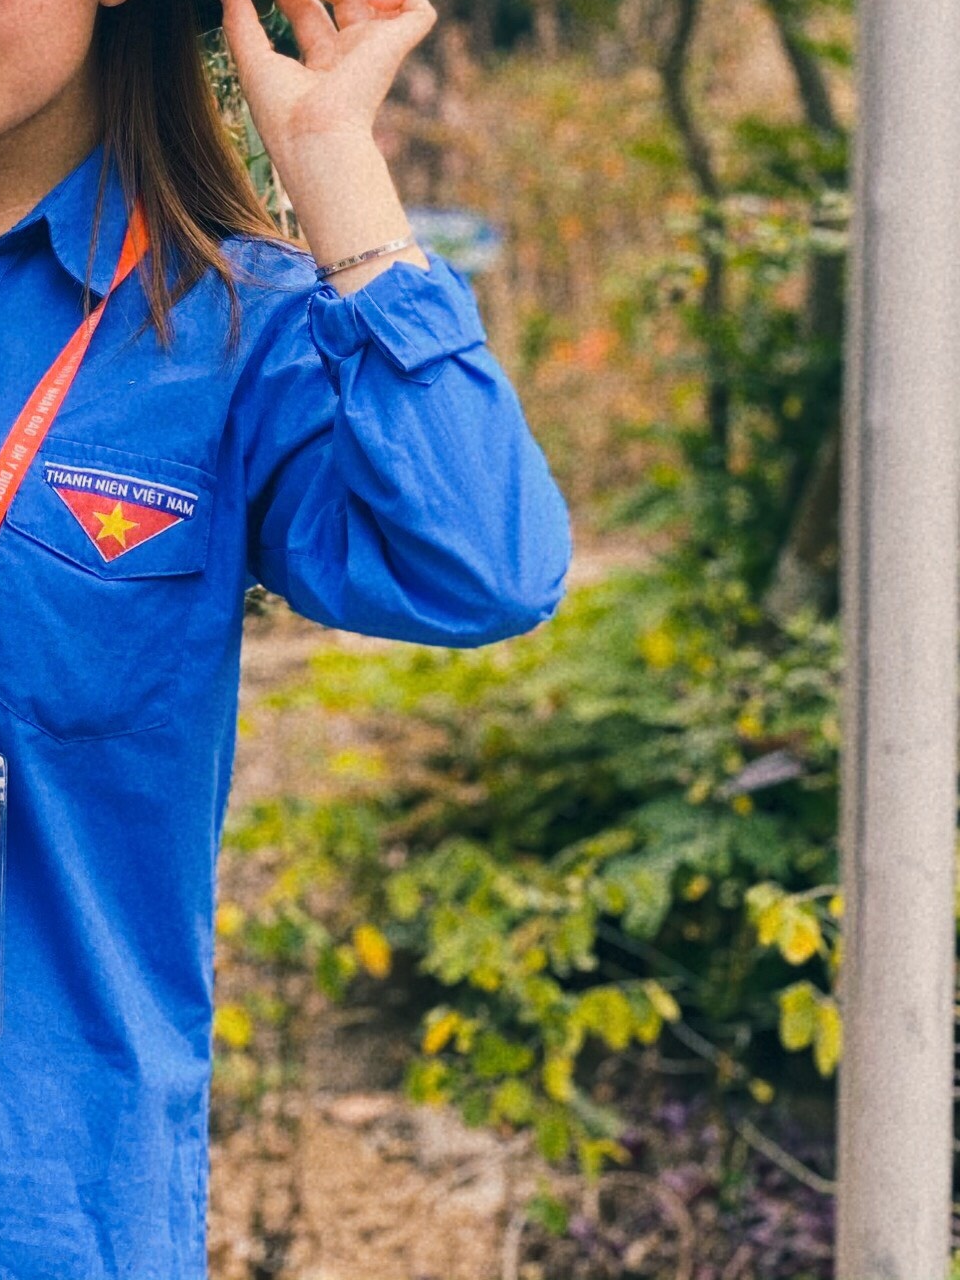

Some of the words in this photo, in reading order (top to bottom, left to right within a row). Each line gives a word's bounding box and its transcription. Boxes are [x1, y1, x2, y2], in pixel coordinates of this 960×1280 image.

[4, 459, 17, 470] Y
[47, 470, 92, 487] THANH
[95, 479, 128, 496] NIÊN
[133, 486, 165, 505] VIỆT
[166, 496, 194, 517] NAM
